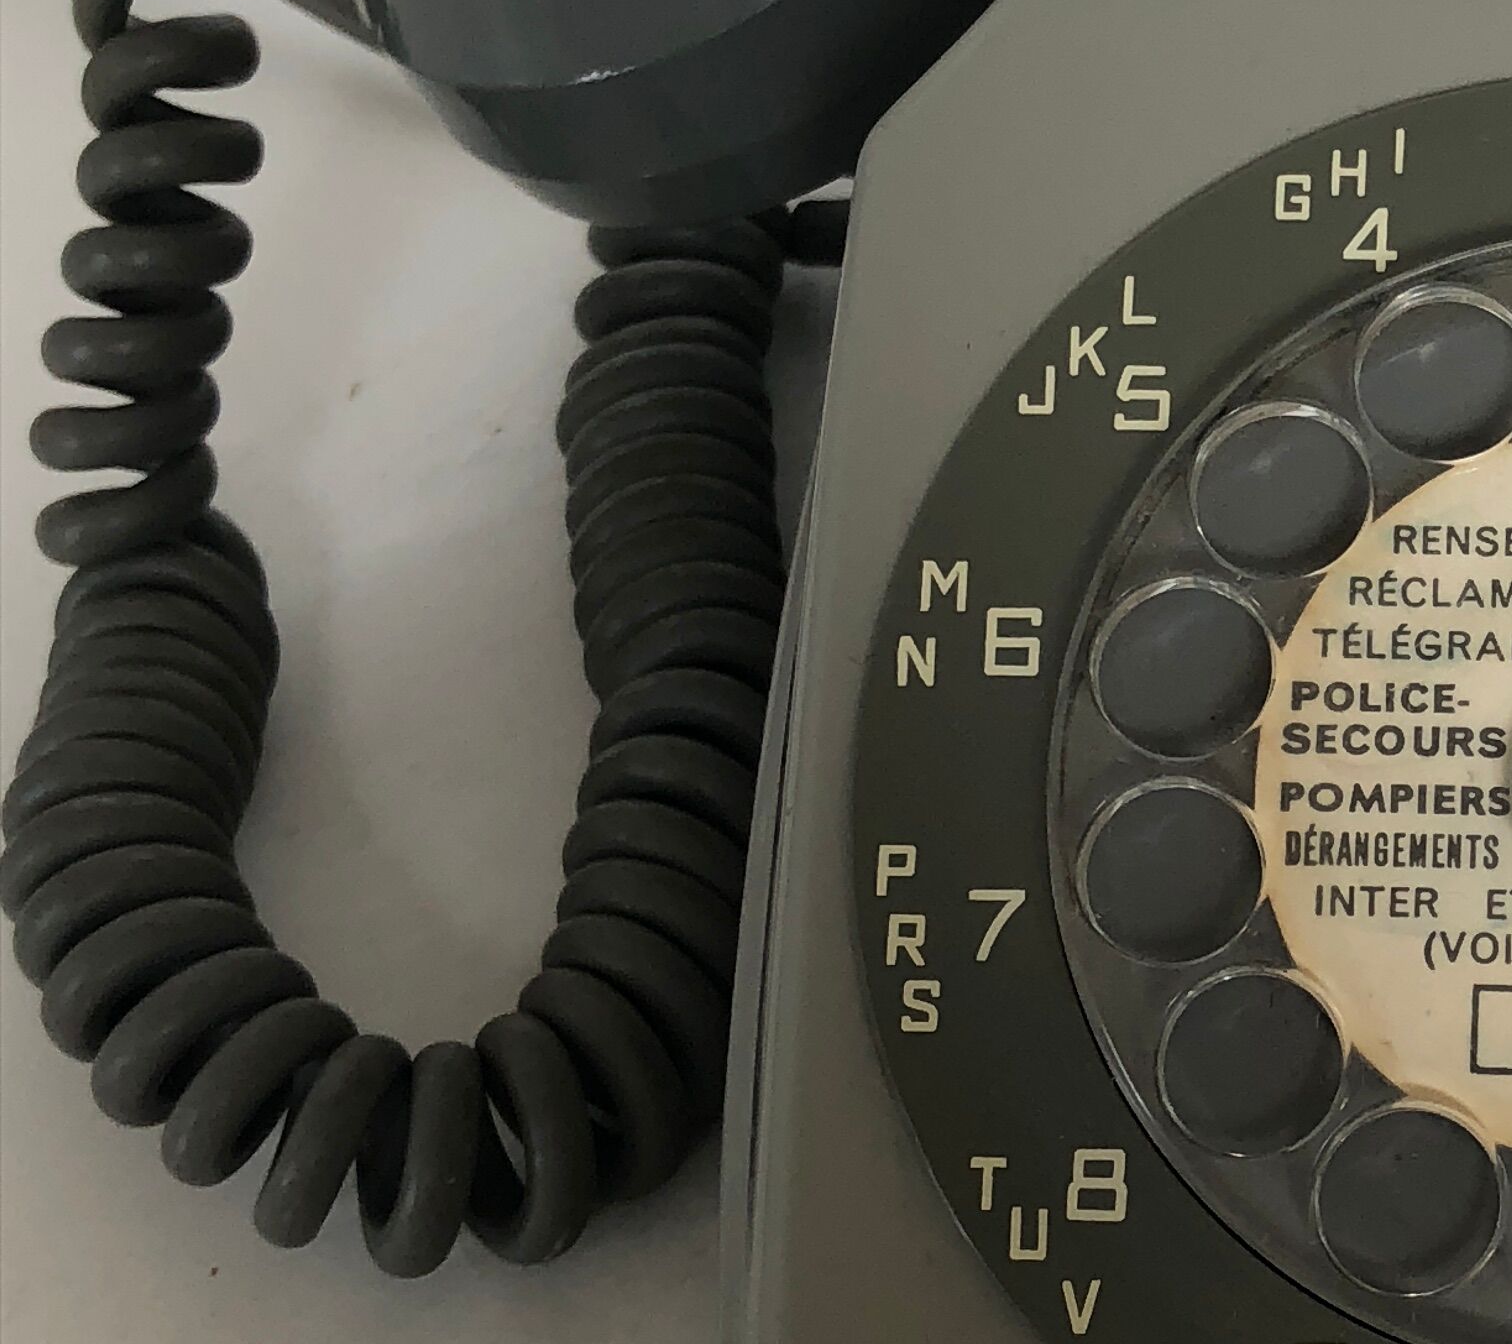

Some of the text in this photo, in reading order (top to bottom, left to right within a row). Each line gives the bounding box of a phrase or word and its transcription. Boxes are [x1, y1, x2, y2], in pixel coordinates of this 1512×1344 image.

[1342, 207, 1398, 272] 4
[1113, 364, 1171, 431] 5
[983, 607, 1043, 677] 6
[1290, 680, 1471, 714] POLICE-
[1280, 721, 1508, 758] SECOURS
[1279, 781, 1512, 817] POMPIERS
[1284, 823, 1501, 870] DÉRANGEMENTS
[968, 889, 1026, 961] 7
[1313, 884, 1439, 919] INTER
[1066, 1148, 1128, 1222] 8
